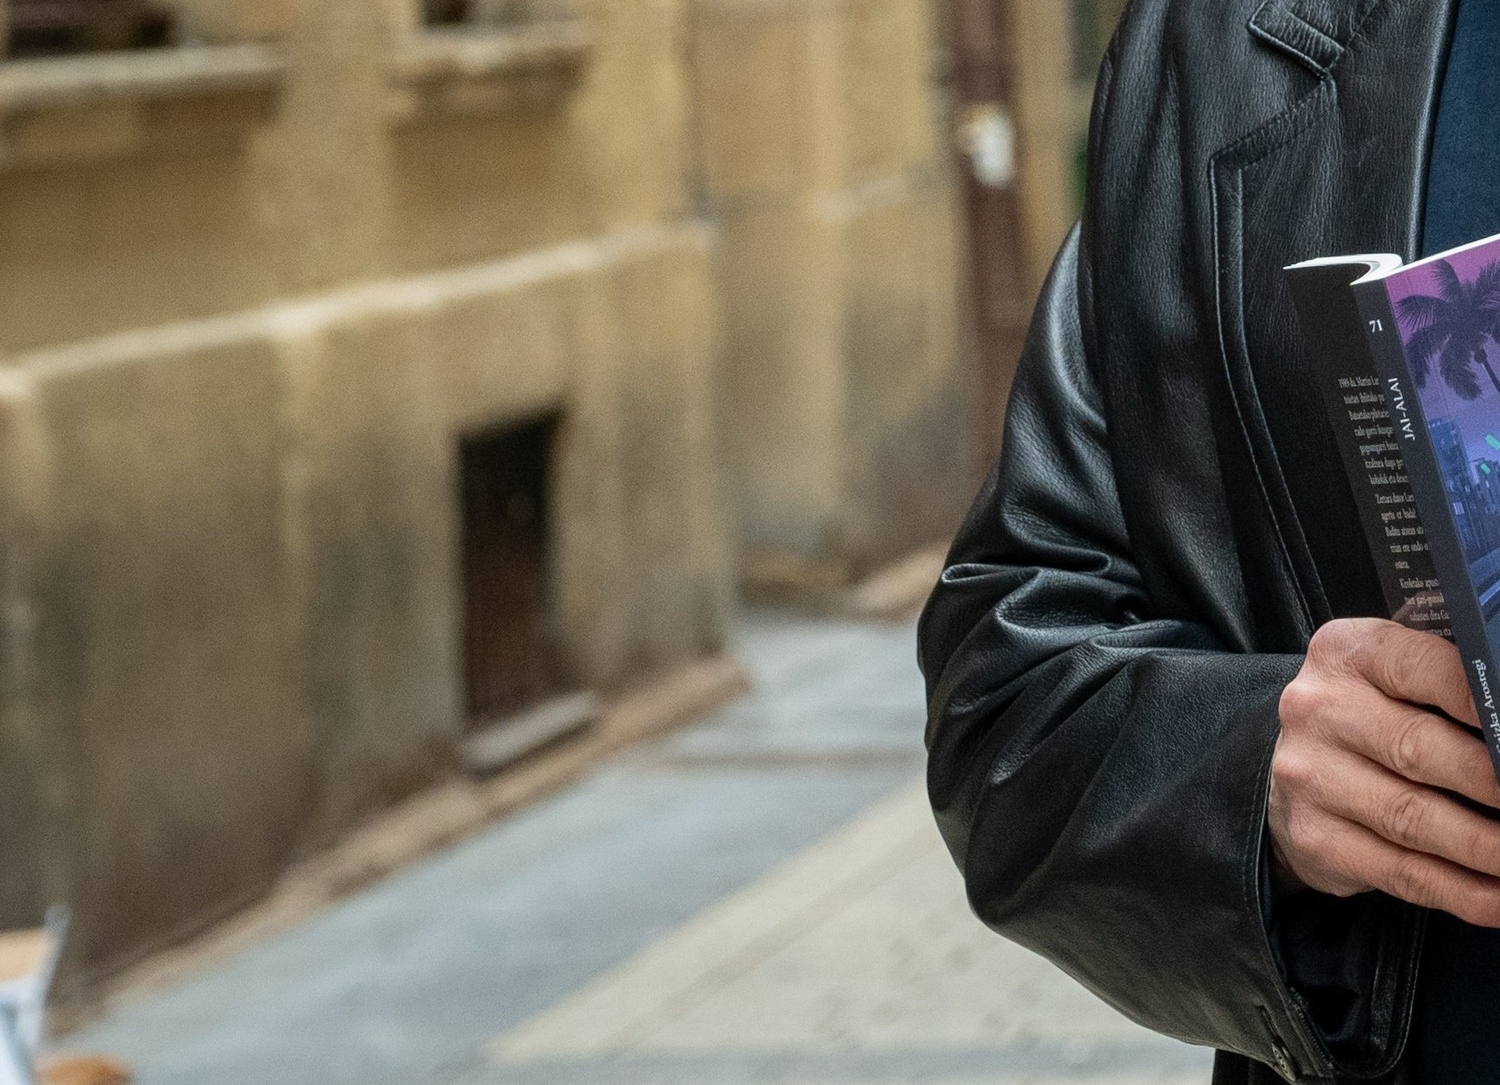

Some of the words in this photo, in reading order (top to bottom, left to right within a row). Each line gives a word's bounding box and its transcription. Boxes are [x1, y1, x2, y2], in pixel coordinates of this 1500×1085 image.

[1369, 319, 1384, 333] 71
[1388, 377, 1416, 441] JAI-ALAI
[1472, 659, 1496, 710] Arostegi
